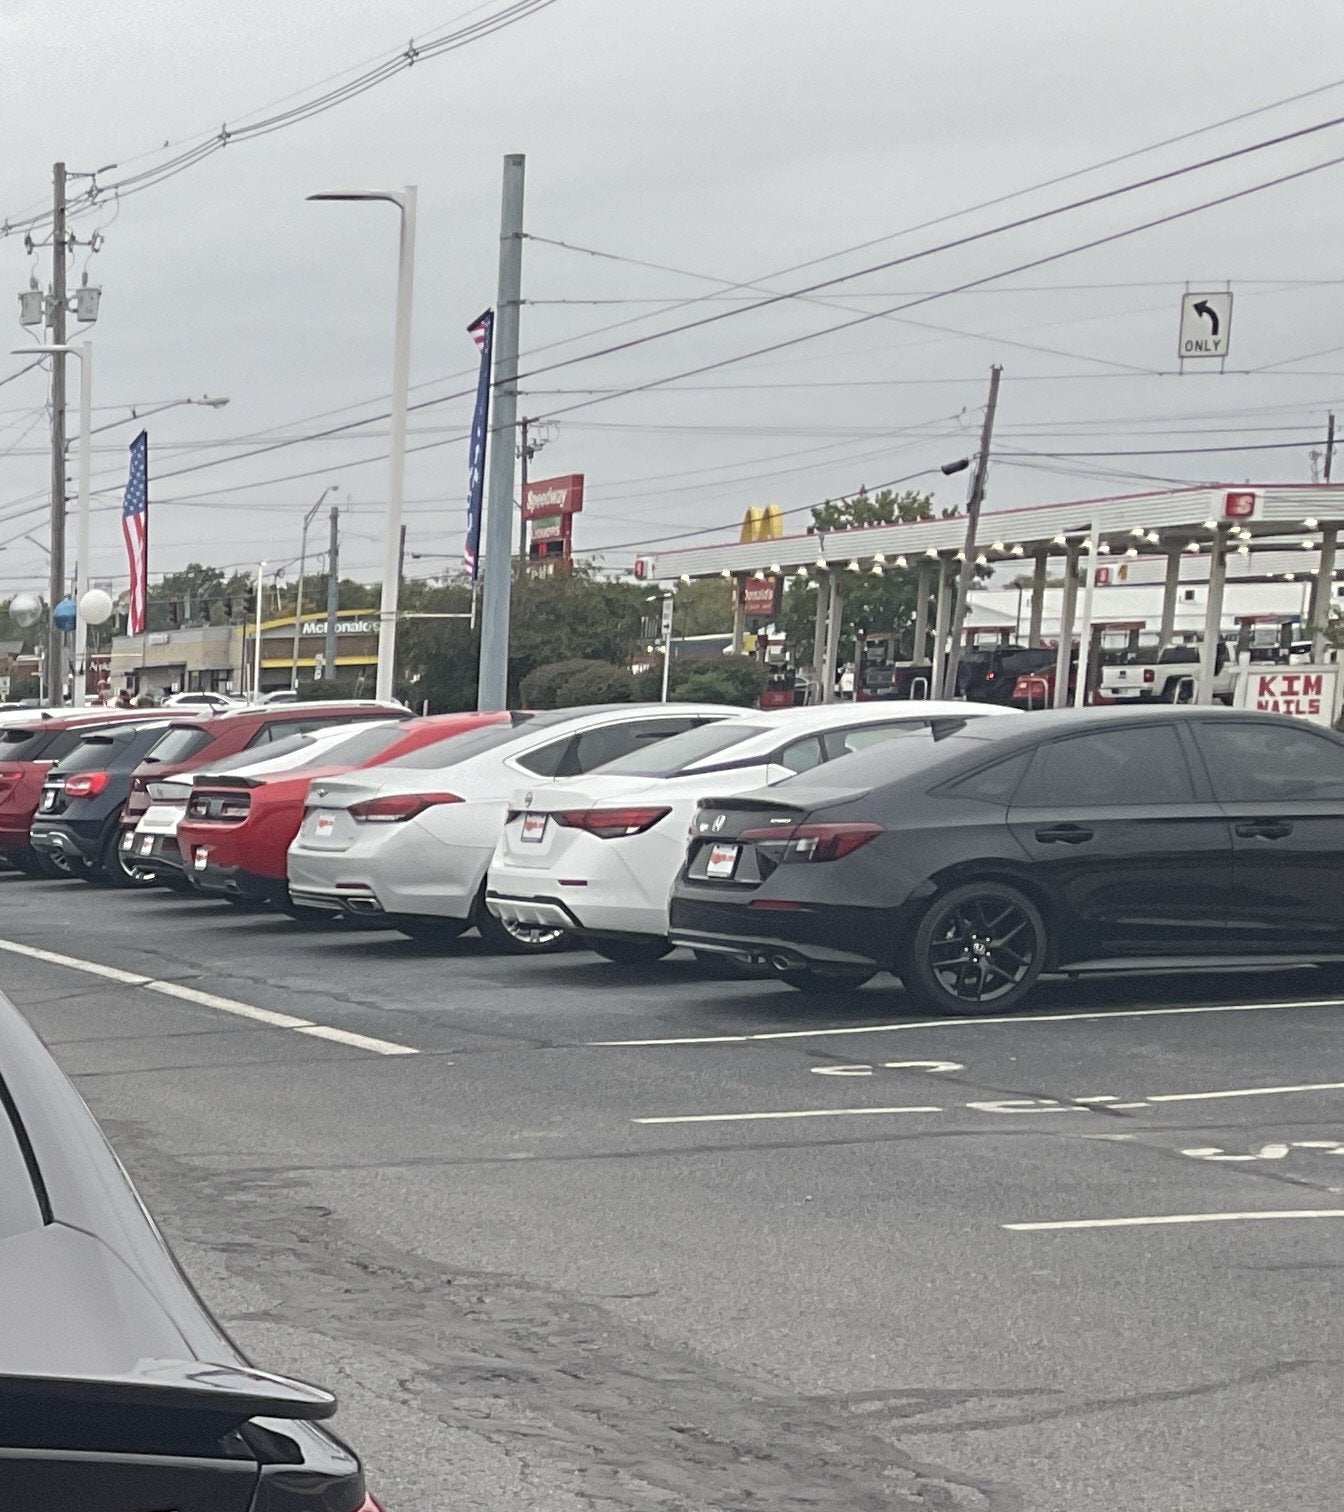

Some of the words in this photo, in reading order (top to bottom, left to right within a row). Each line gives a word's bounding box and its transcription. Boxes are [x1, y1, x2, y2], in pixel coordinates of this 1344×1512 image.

[1185, 340, 1221, 352] ONLY
[1258, 674, 1323, 696] KIM
[1257, 699, 1320, 715] NAILS
